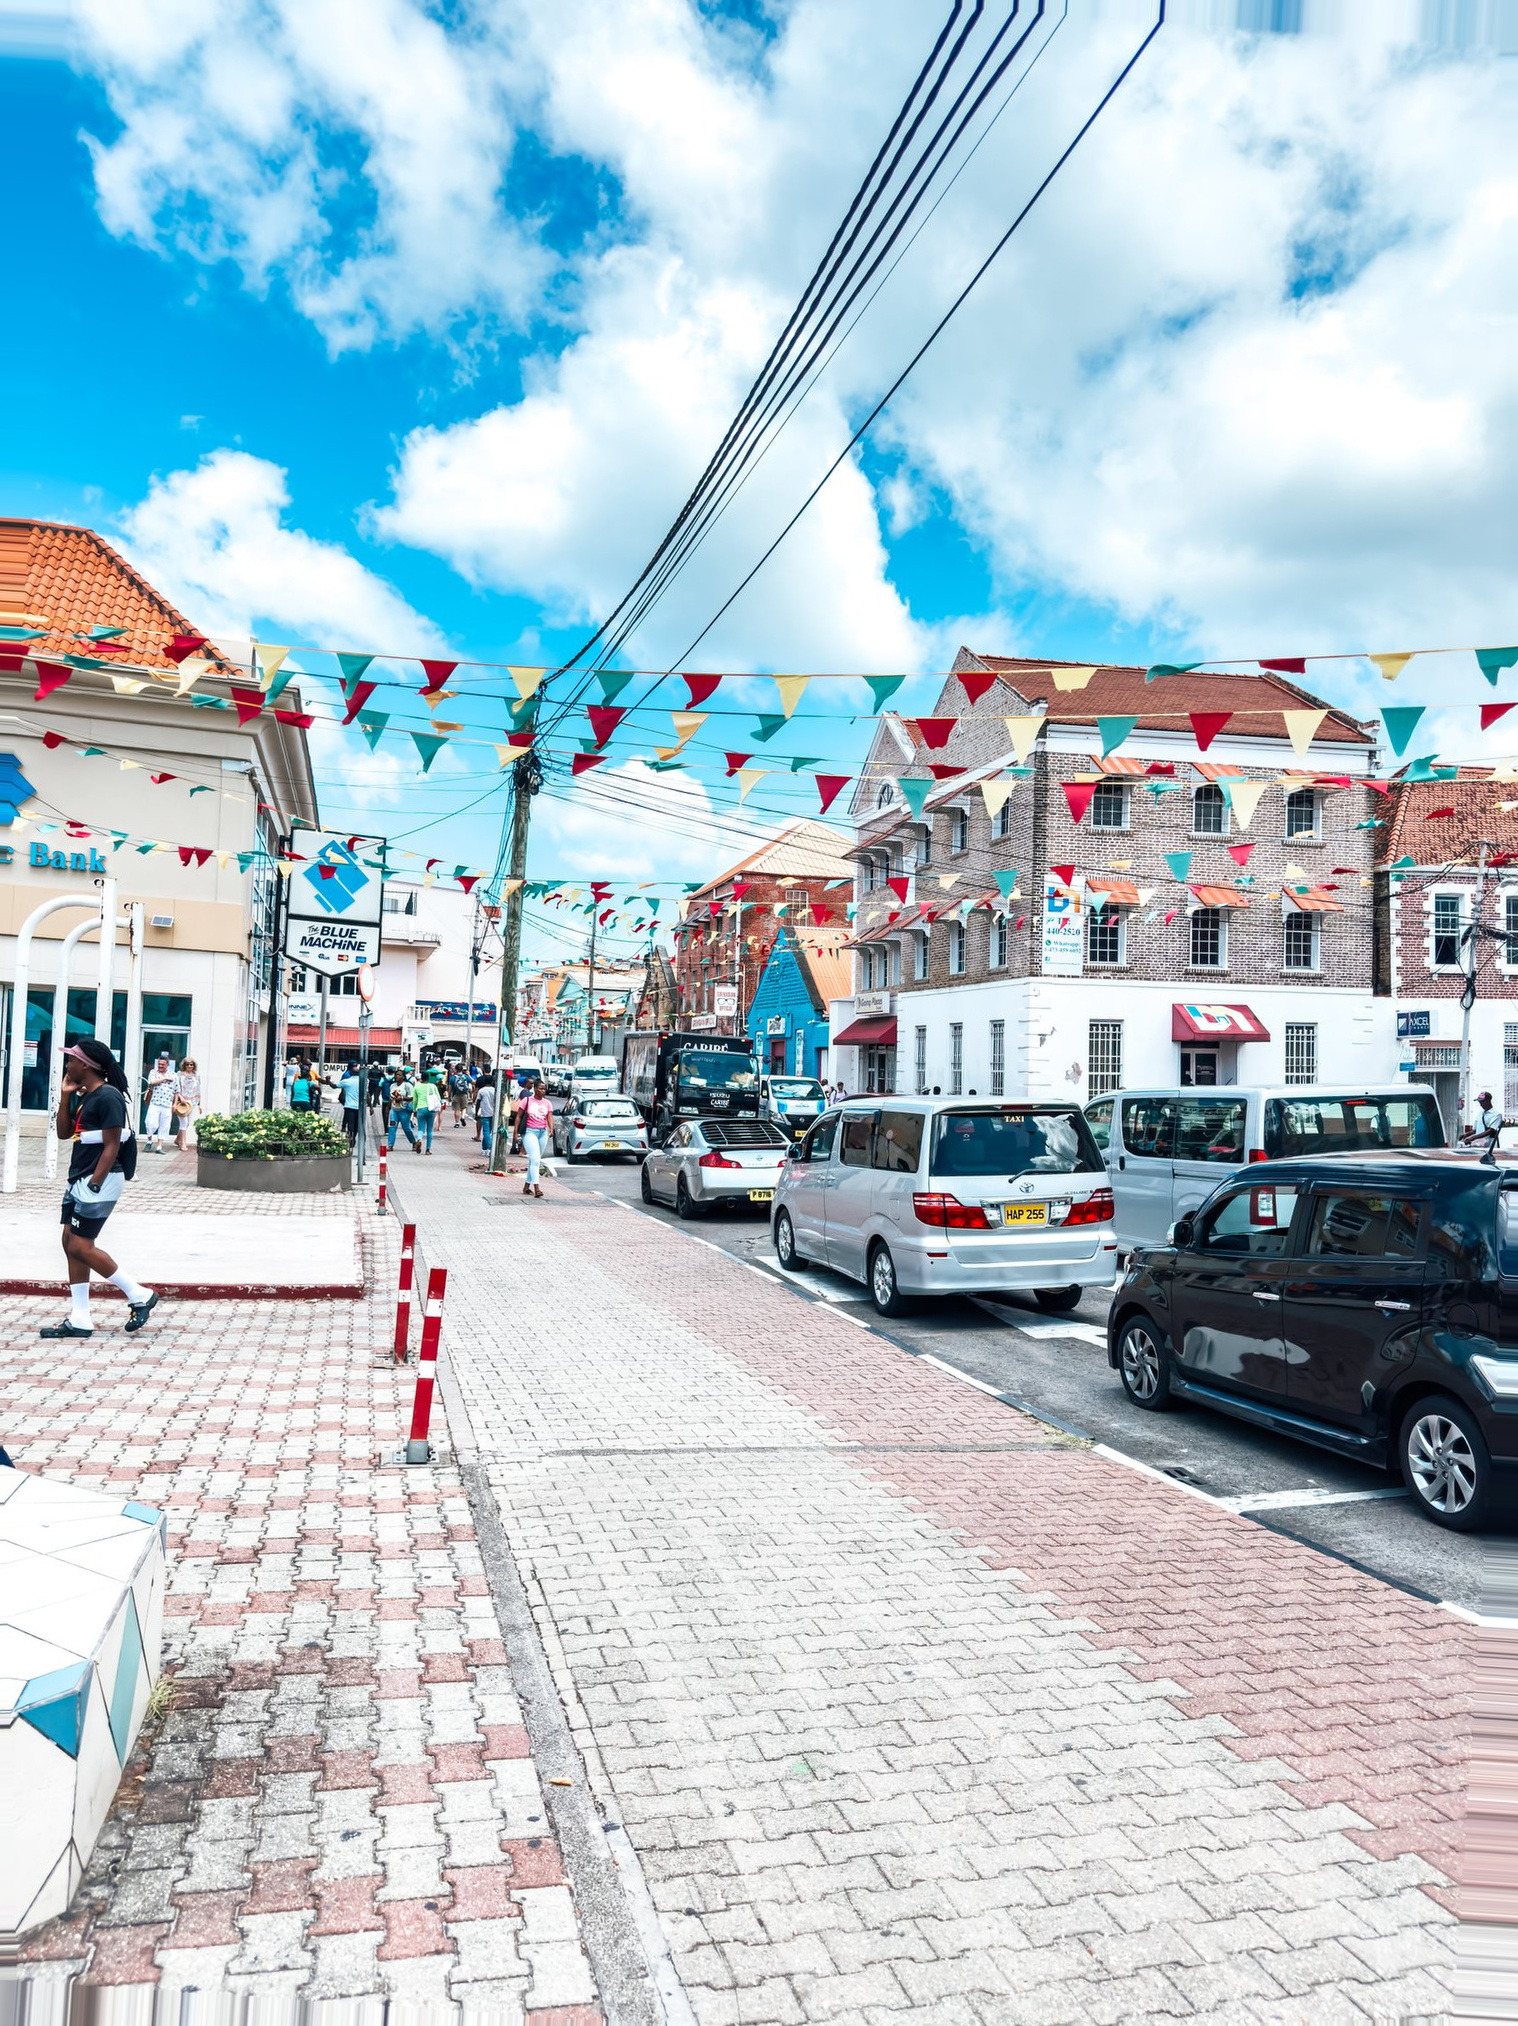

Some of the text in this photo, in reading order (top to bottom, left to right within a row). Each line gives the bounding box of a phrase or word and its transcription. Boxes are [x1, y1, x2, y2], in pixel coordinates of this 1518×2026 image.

[29, 841, 106, 873] Bank
[320, 926, 358, 939] BLUE
[1006, 1209, 1045, 1220] HAP 255
